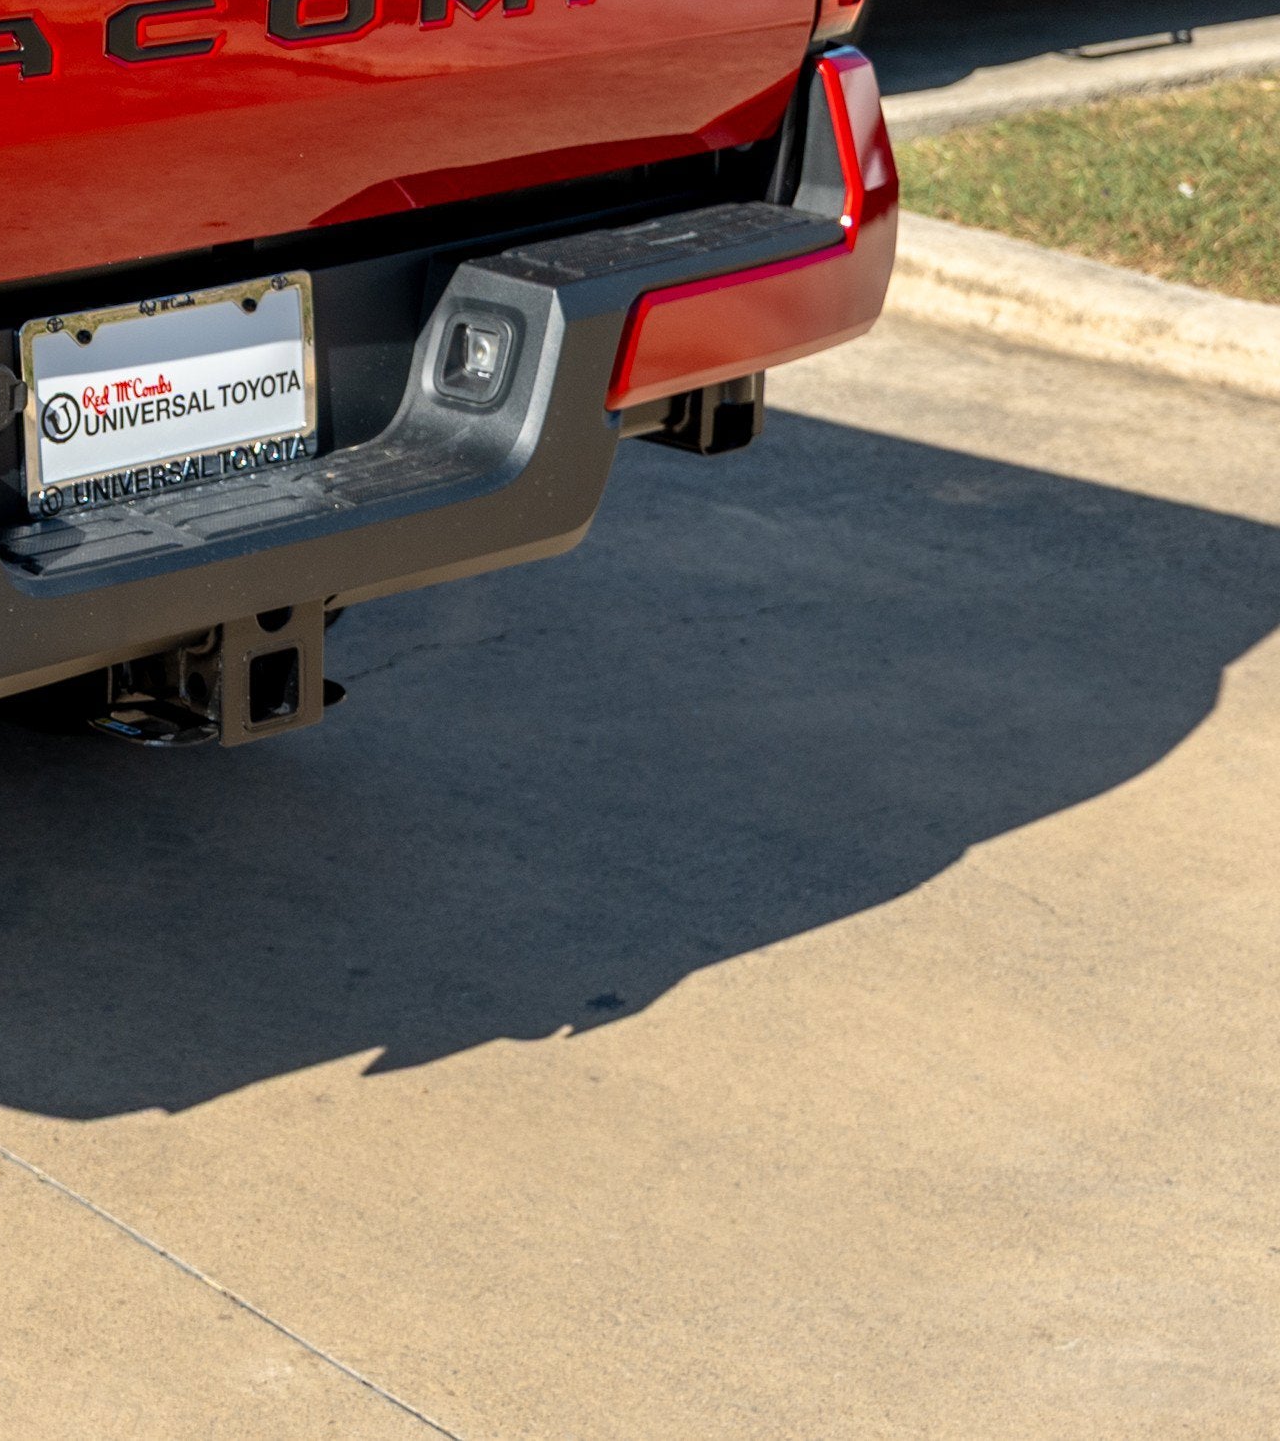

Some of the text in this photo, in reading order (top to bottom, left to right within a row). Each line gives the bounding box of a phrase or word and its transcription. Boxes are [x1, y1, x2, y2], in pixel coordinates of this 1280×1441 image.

[83, 386, 109, 415] Red
[84, 389, 215, 436] UNIVERSAL
[218, 370, 301, 408] TOYOTA
[72, 454, 213, 505] UNIVERSAL
[217, 433, 308, 474] TOYOTA
